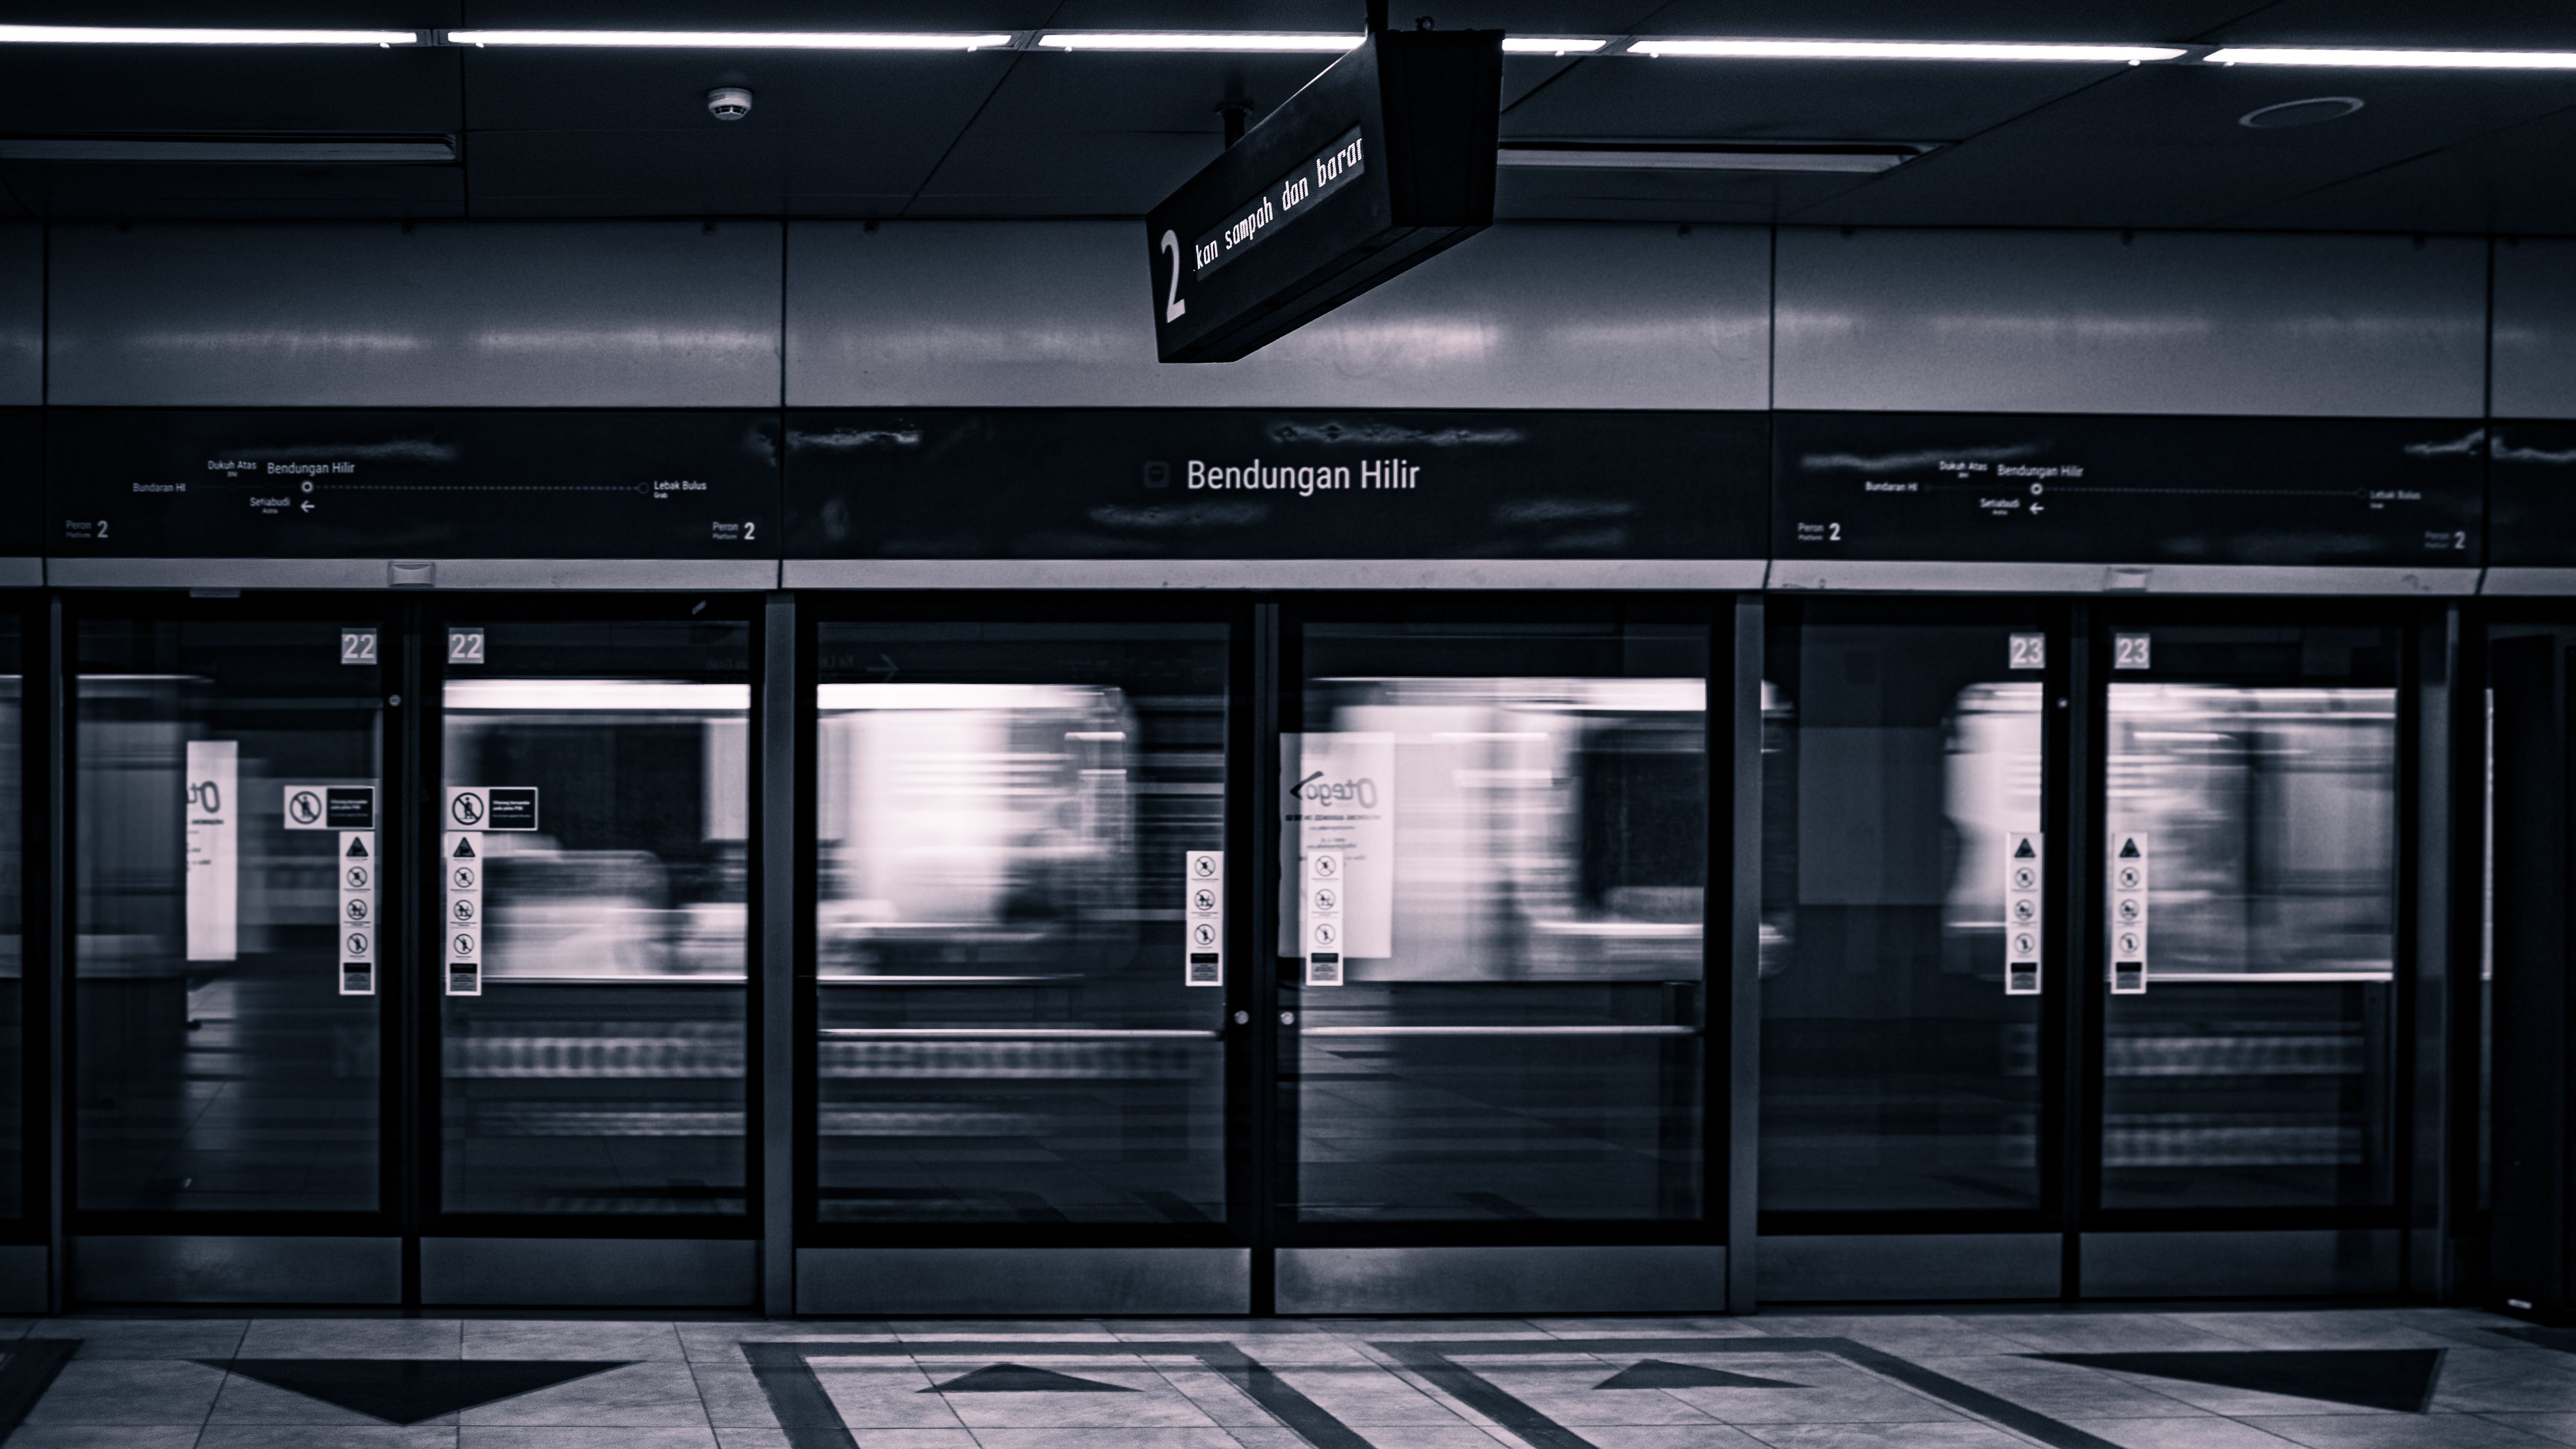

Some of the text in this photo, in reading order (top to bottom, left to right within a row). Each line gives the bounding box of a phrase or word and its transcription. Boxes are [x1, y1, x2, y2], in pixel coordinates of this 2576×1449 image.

[1225, 196, 1273, 250] sampah
[1281, 177, 1309, 211] dan
[1161, 229, 1186, 323] 2
[207, 460, 257, 470] Dukuh Atas
[267, 461, 355, 476] Bendungan Hilir
[1997, 463, 2084, 479] Bendungan Hilir
[654, 480, 707, 490] Lebak Bulus
[1187, 458, 1420, 497] Bendungan Hilir
[132, 482, 186, 492] Bundaran HI
[249, 497, 290, 507] Setiabudi
[97, 520, 109, 538] 2
[712, 521, 739, 531] Peron
[744, 522, 755, 540] 2
[1829, 523, 1841, 541] 2
[2454, 530, 2466, 549] 2
[343, 634, 376, 660] 22
[450, 634, 483, 660] 22
[2012, 638, 2043, 664] 23
[2118, 638, 2149, 664] 23
